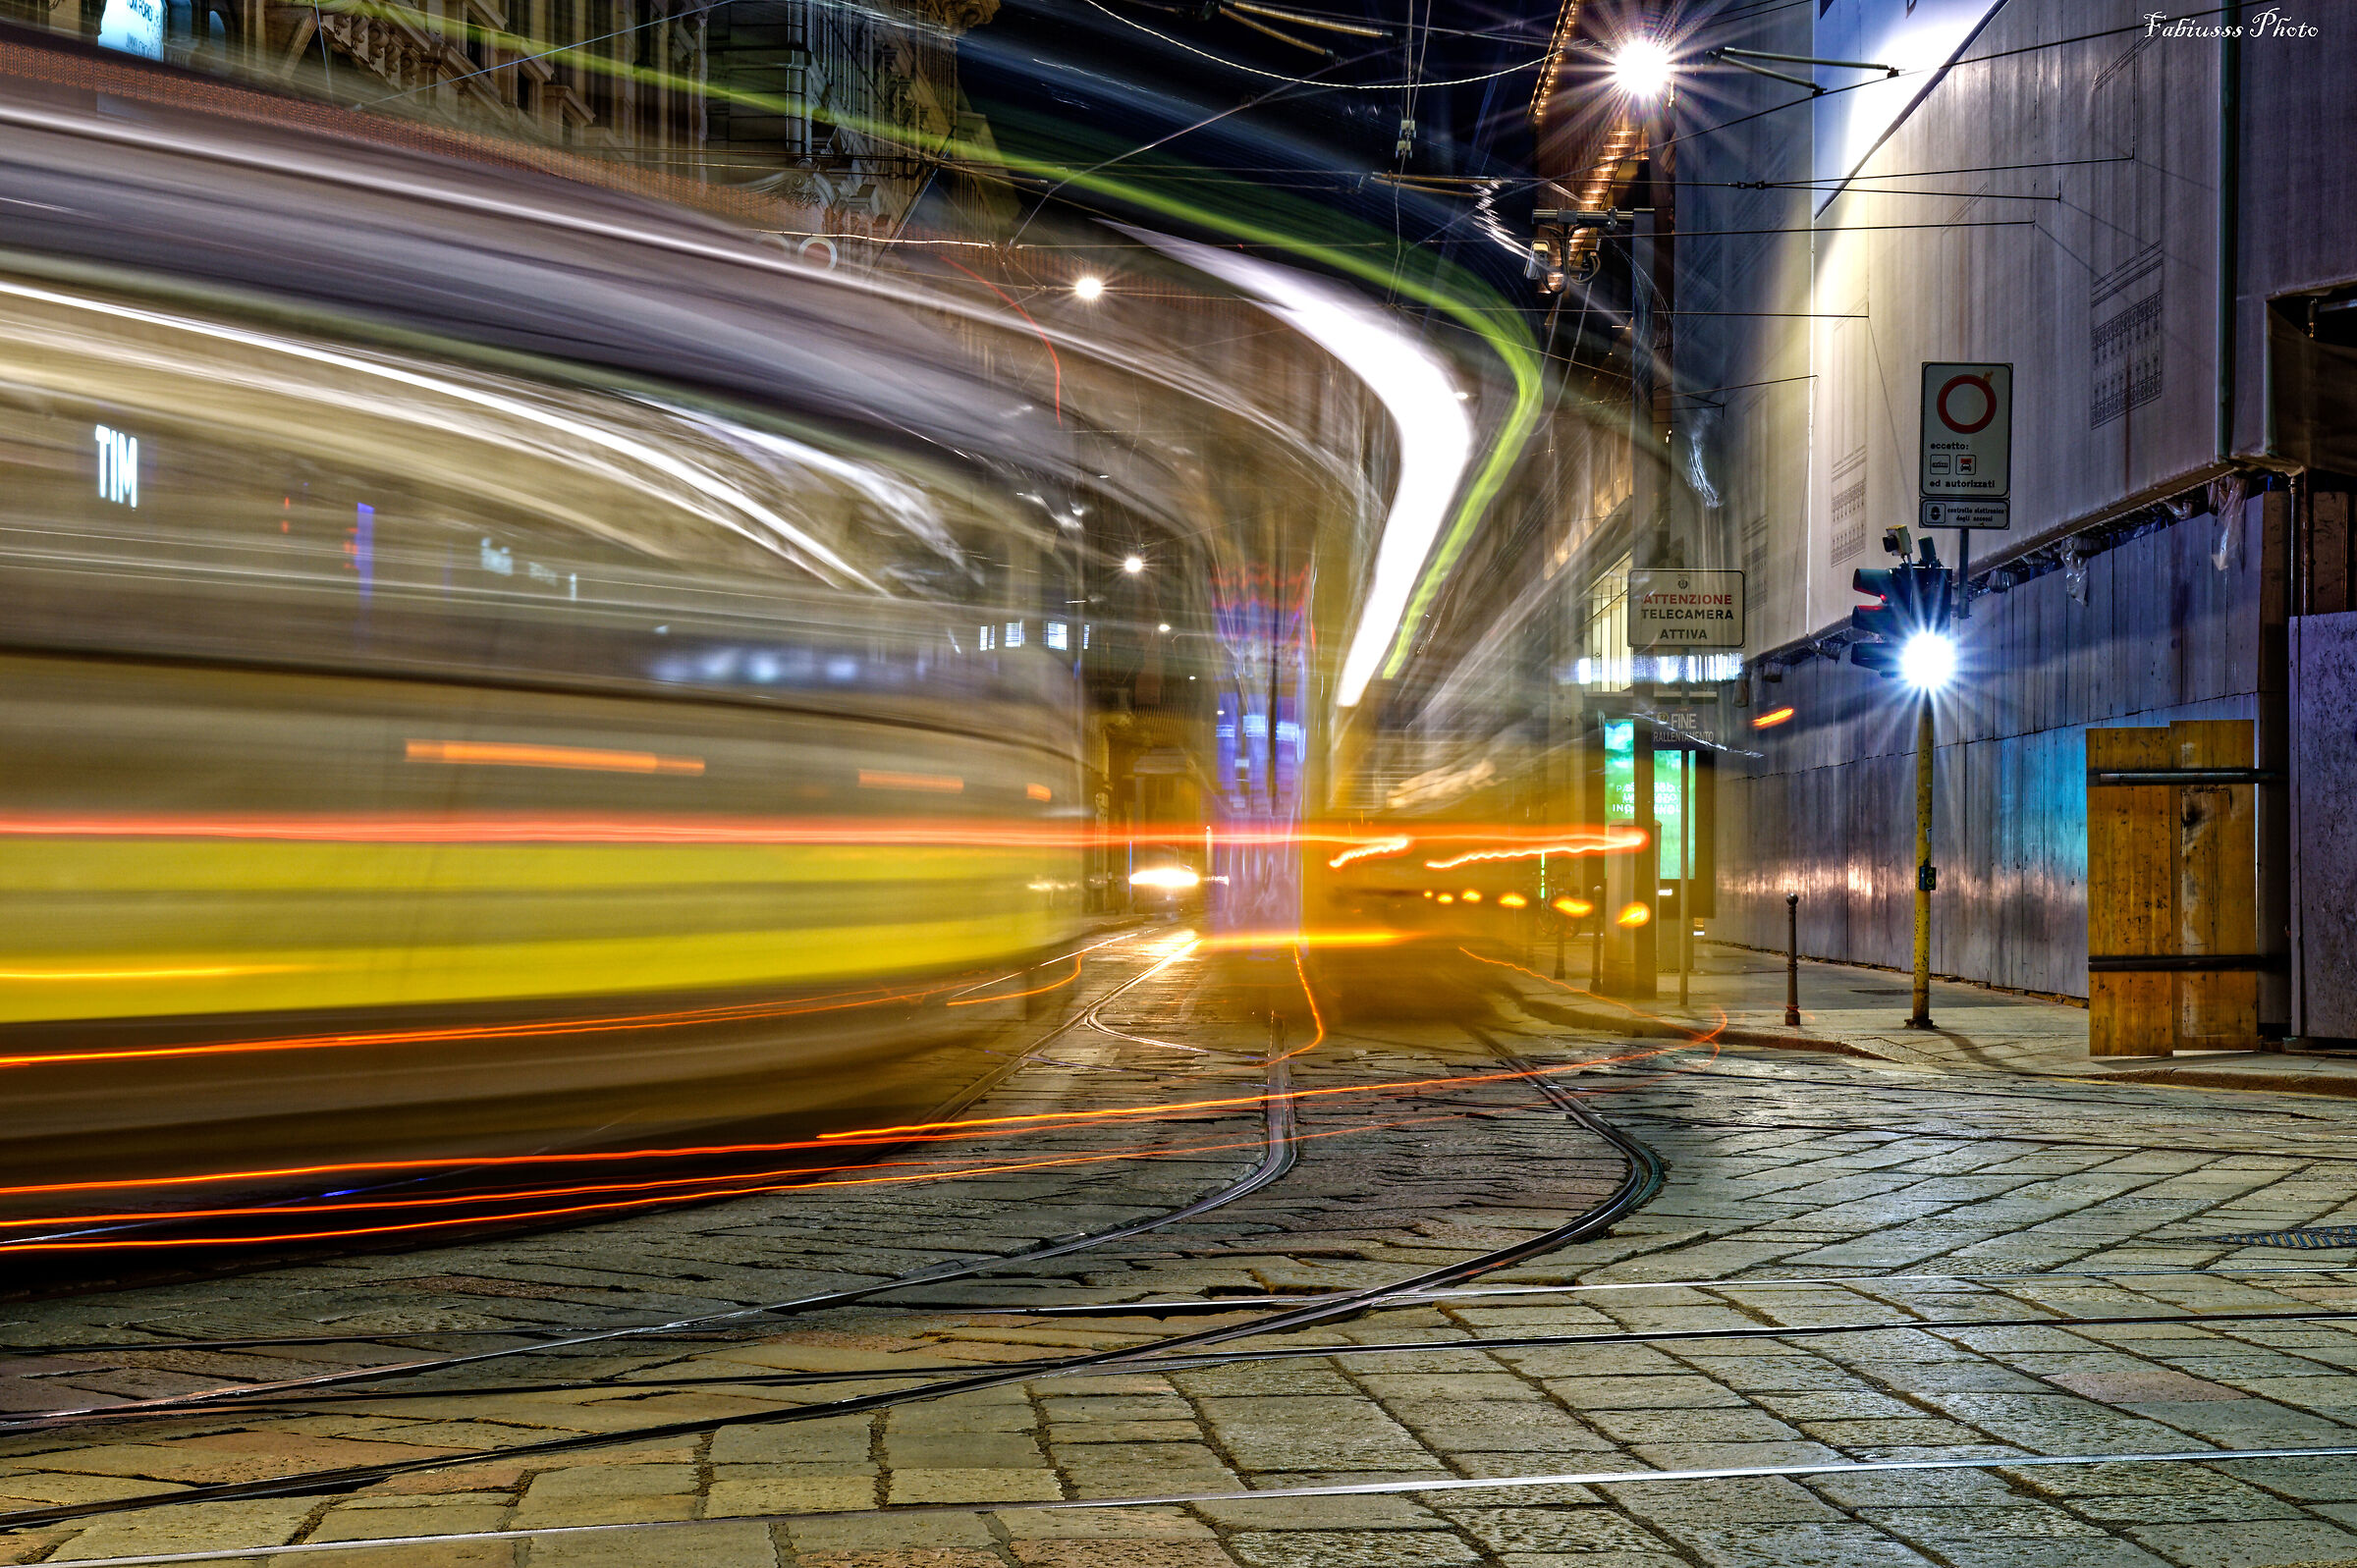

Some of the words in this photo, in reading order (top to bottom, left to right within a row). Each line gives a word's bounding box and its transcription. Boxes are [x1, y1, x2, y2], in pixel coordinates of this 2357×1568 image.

[95, 424, 137, 509] TIM
[1929, 479, 1941, 488] ed
[1946, 479, 1996, 488] autorizzati
[1643, 593, 1732, 605] ATTENZIONE
[1641, 609, 1734, 621] TELECAMERA
[1660, 628, 1708, 640] ATTIVA
[1671, 713, 1697, 729] FINE
